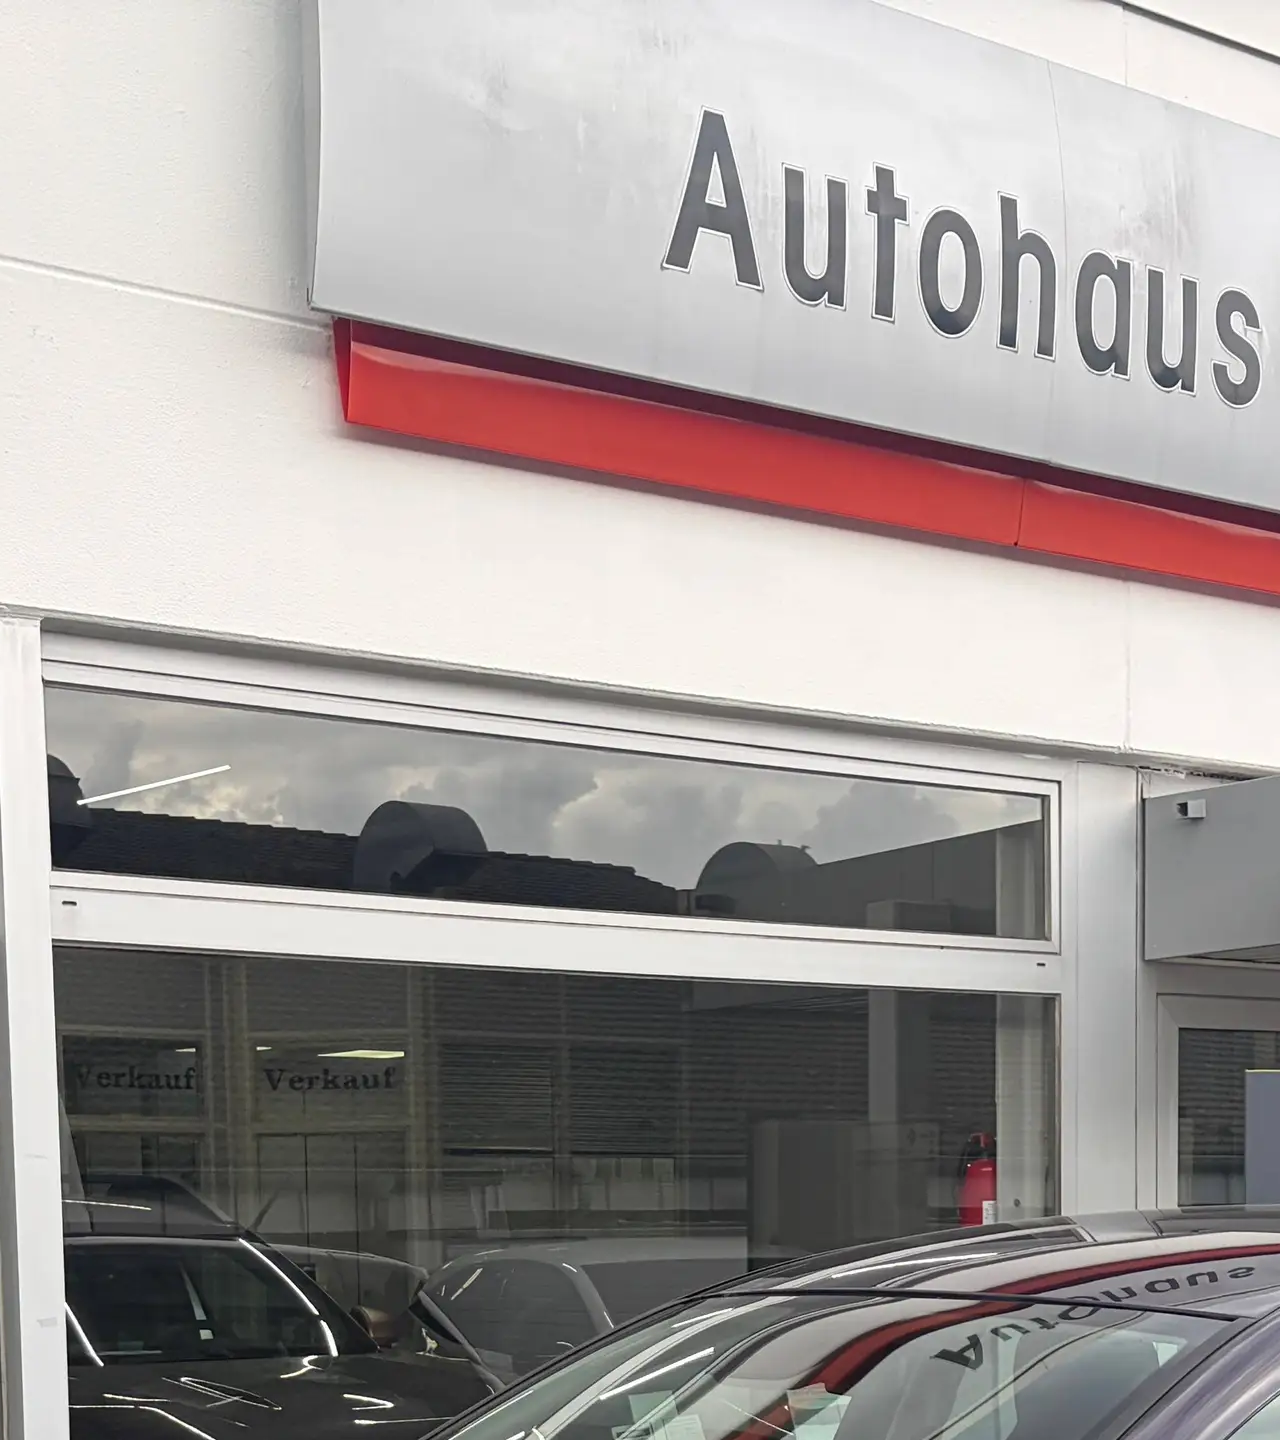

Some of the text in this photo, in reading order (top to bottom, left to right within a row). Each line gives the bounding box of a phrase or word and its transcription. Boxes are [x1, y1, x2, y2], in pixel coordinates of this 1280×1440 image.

[661, 106, 1263, 409] Autohaus
[75, 1064, 195, 1091] Verkauf
[263, 1066, 396, 1092] Verkauf
